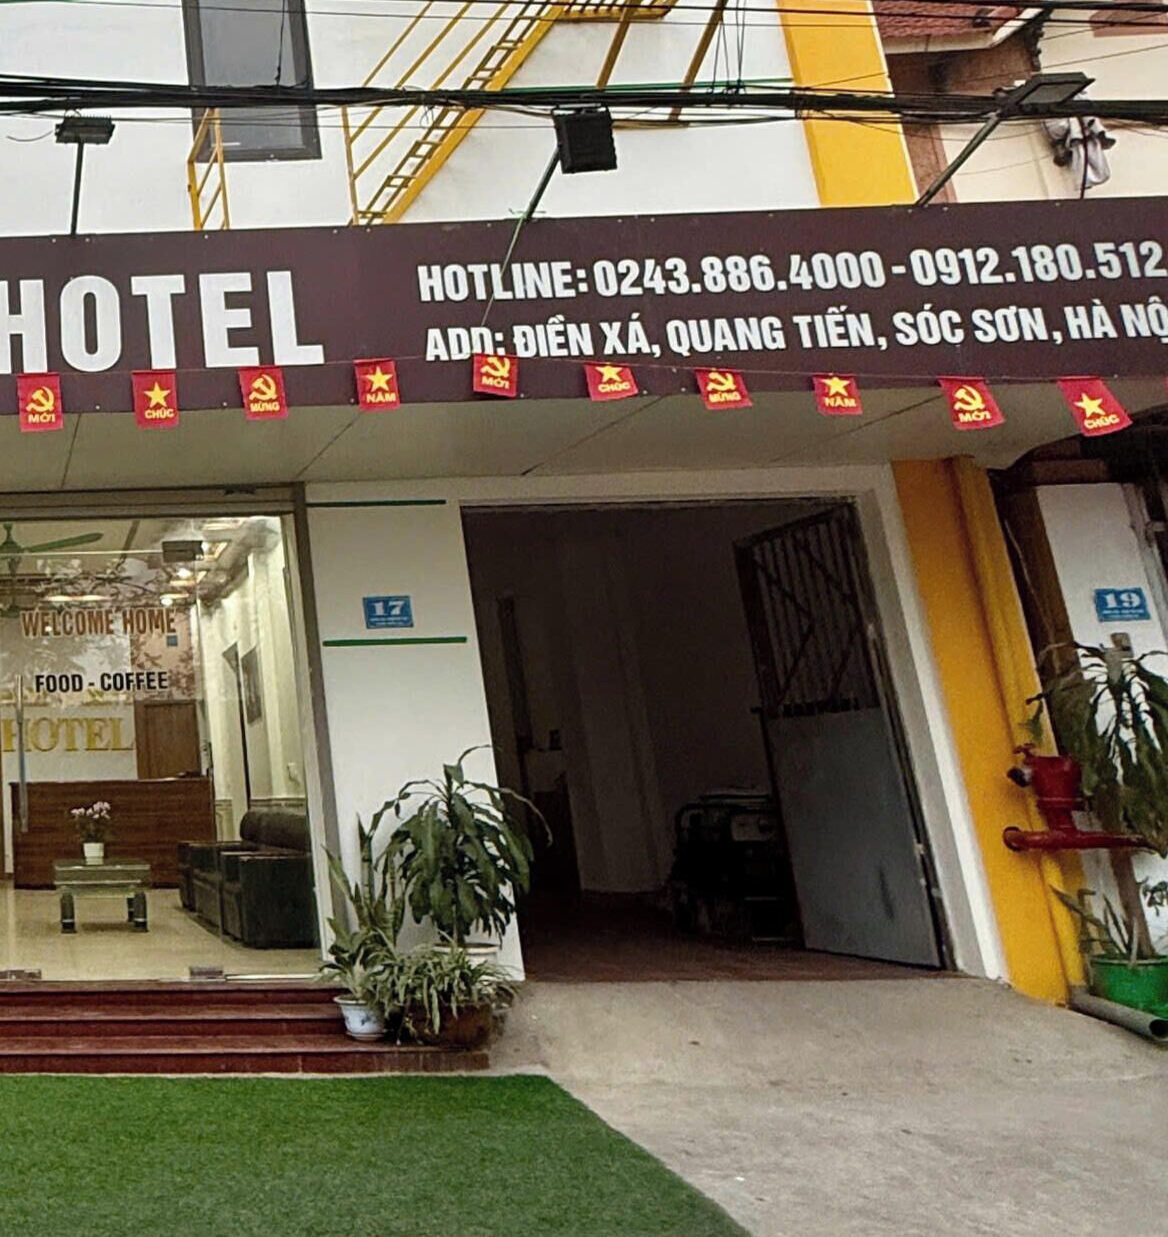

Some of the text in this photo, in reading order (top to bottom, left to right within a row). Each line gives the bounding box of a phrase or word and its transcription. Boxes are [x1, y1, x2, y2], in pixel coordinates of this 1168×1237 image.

[417, 261, 589, 302] HOTLINE:
[593, 251, 886, 297] 0243.886.4000
[909, 241, 1168, 286] 0912.180.512
[426, 325, 506, 361] ADD:
[513, 314, 594, 358] ĐIỀN
[599, 312, 661, 357] XÁ,
[666, 316, 786, 357] QUANG
[792, 305, 888, 350] TIẾN,
[892, 303, 965, 345] SÓC
[972, 305, 1063, 344] SƠN,
[1064, 298, 1118, 339] HÀ
[373, 600, 405, 616] 17
[1104, 591, 1141, 608] 19
[21, 607, 177, 637] WELCOME HOME
[35, 673, 83, 693] FOOD
[100, 671, 169, 692] COFFEE
[1, 717, 135, 752] HOTEL
